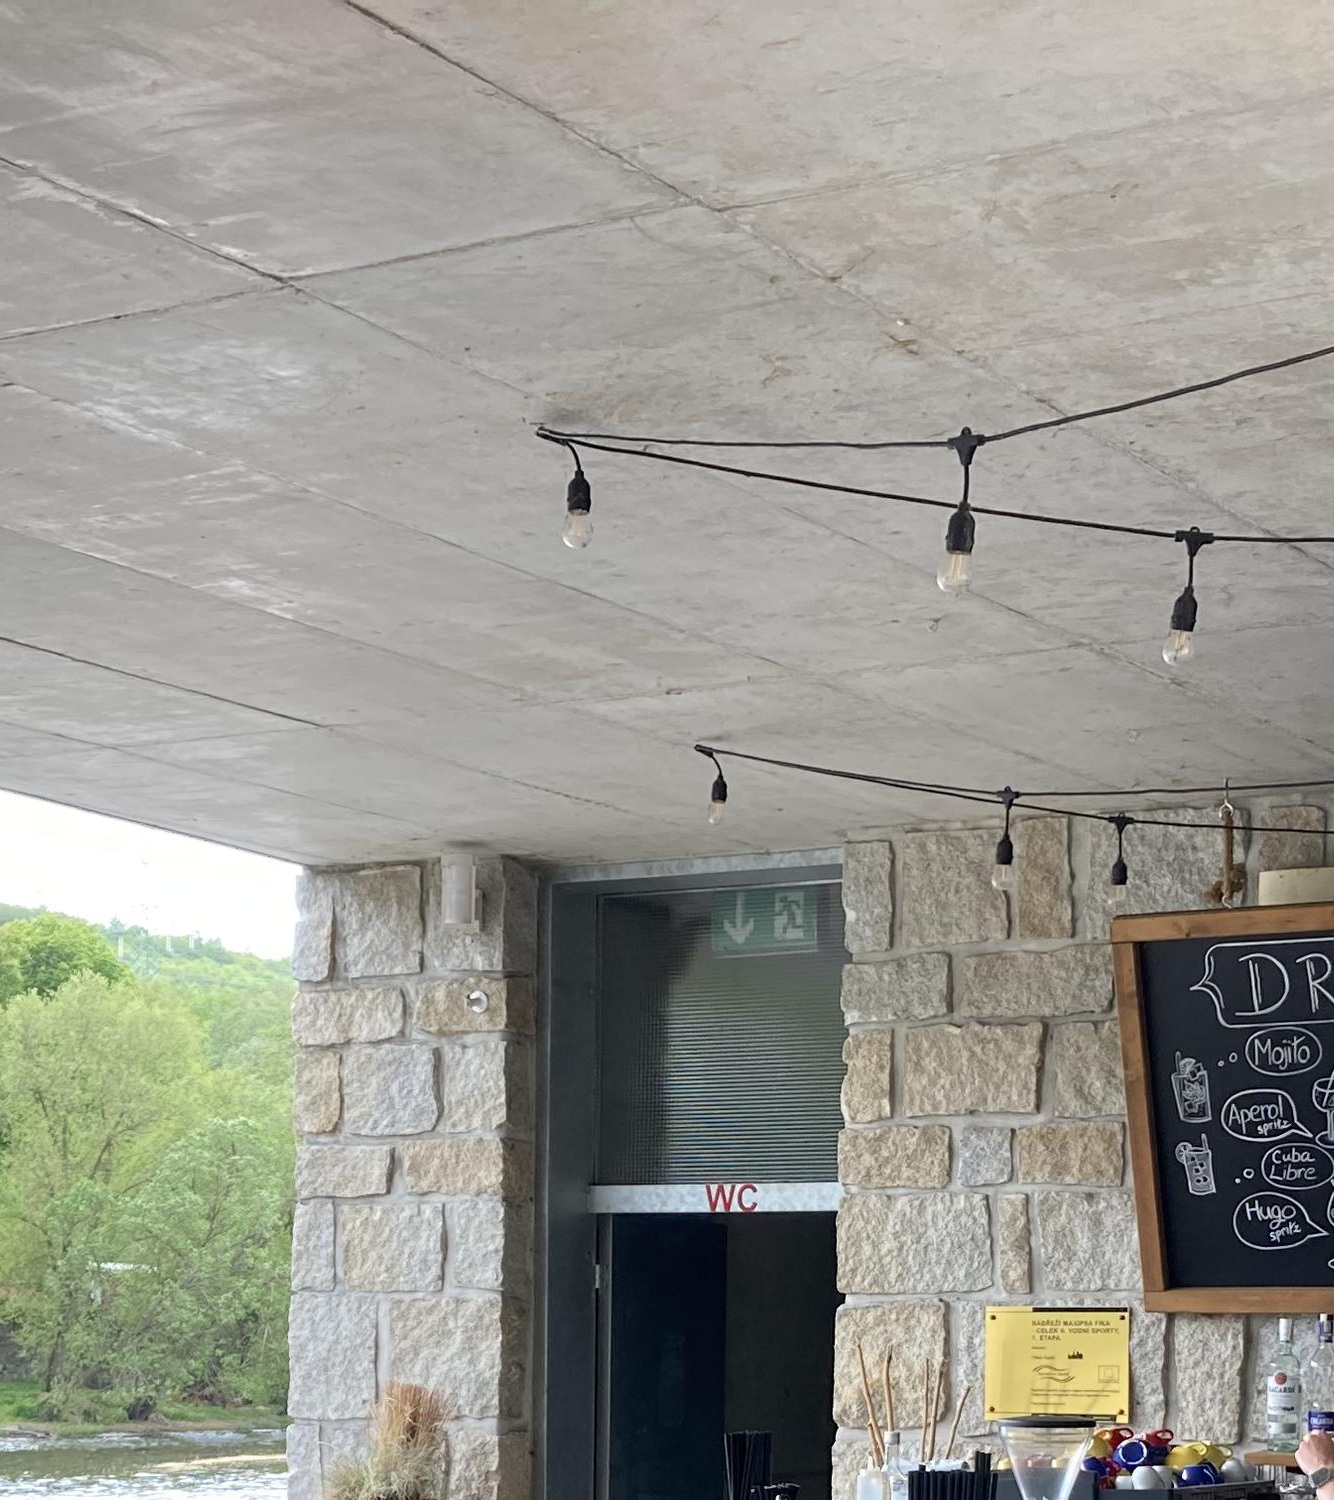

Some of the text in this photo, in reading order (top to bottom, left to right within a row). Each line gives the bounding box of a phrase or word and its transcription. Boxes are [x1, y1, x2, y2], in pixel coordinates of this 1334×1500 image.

[1253, 1035, 1311, 1069] Mojito
[1228, 1094, 1284, 1134] Aperol
[1257, 1115, 1292, 1136] spritz
[1271, 1148, 1316, 1164] Cuba
[1269, 1163, 1318, 1180] Libre
[705, 1183, 758, 1213] WC
[1245, 1200, 1297, 1228] Hugo
[1269, 1220, 1302, 1243] spritz
